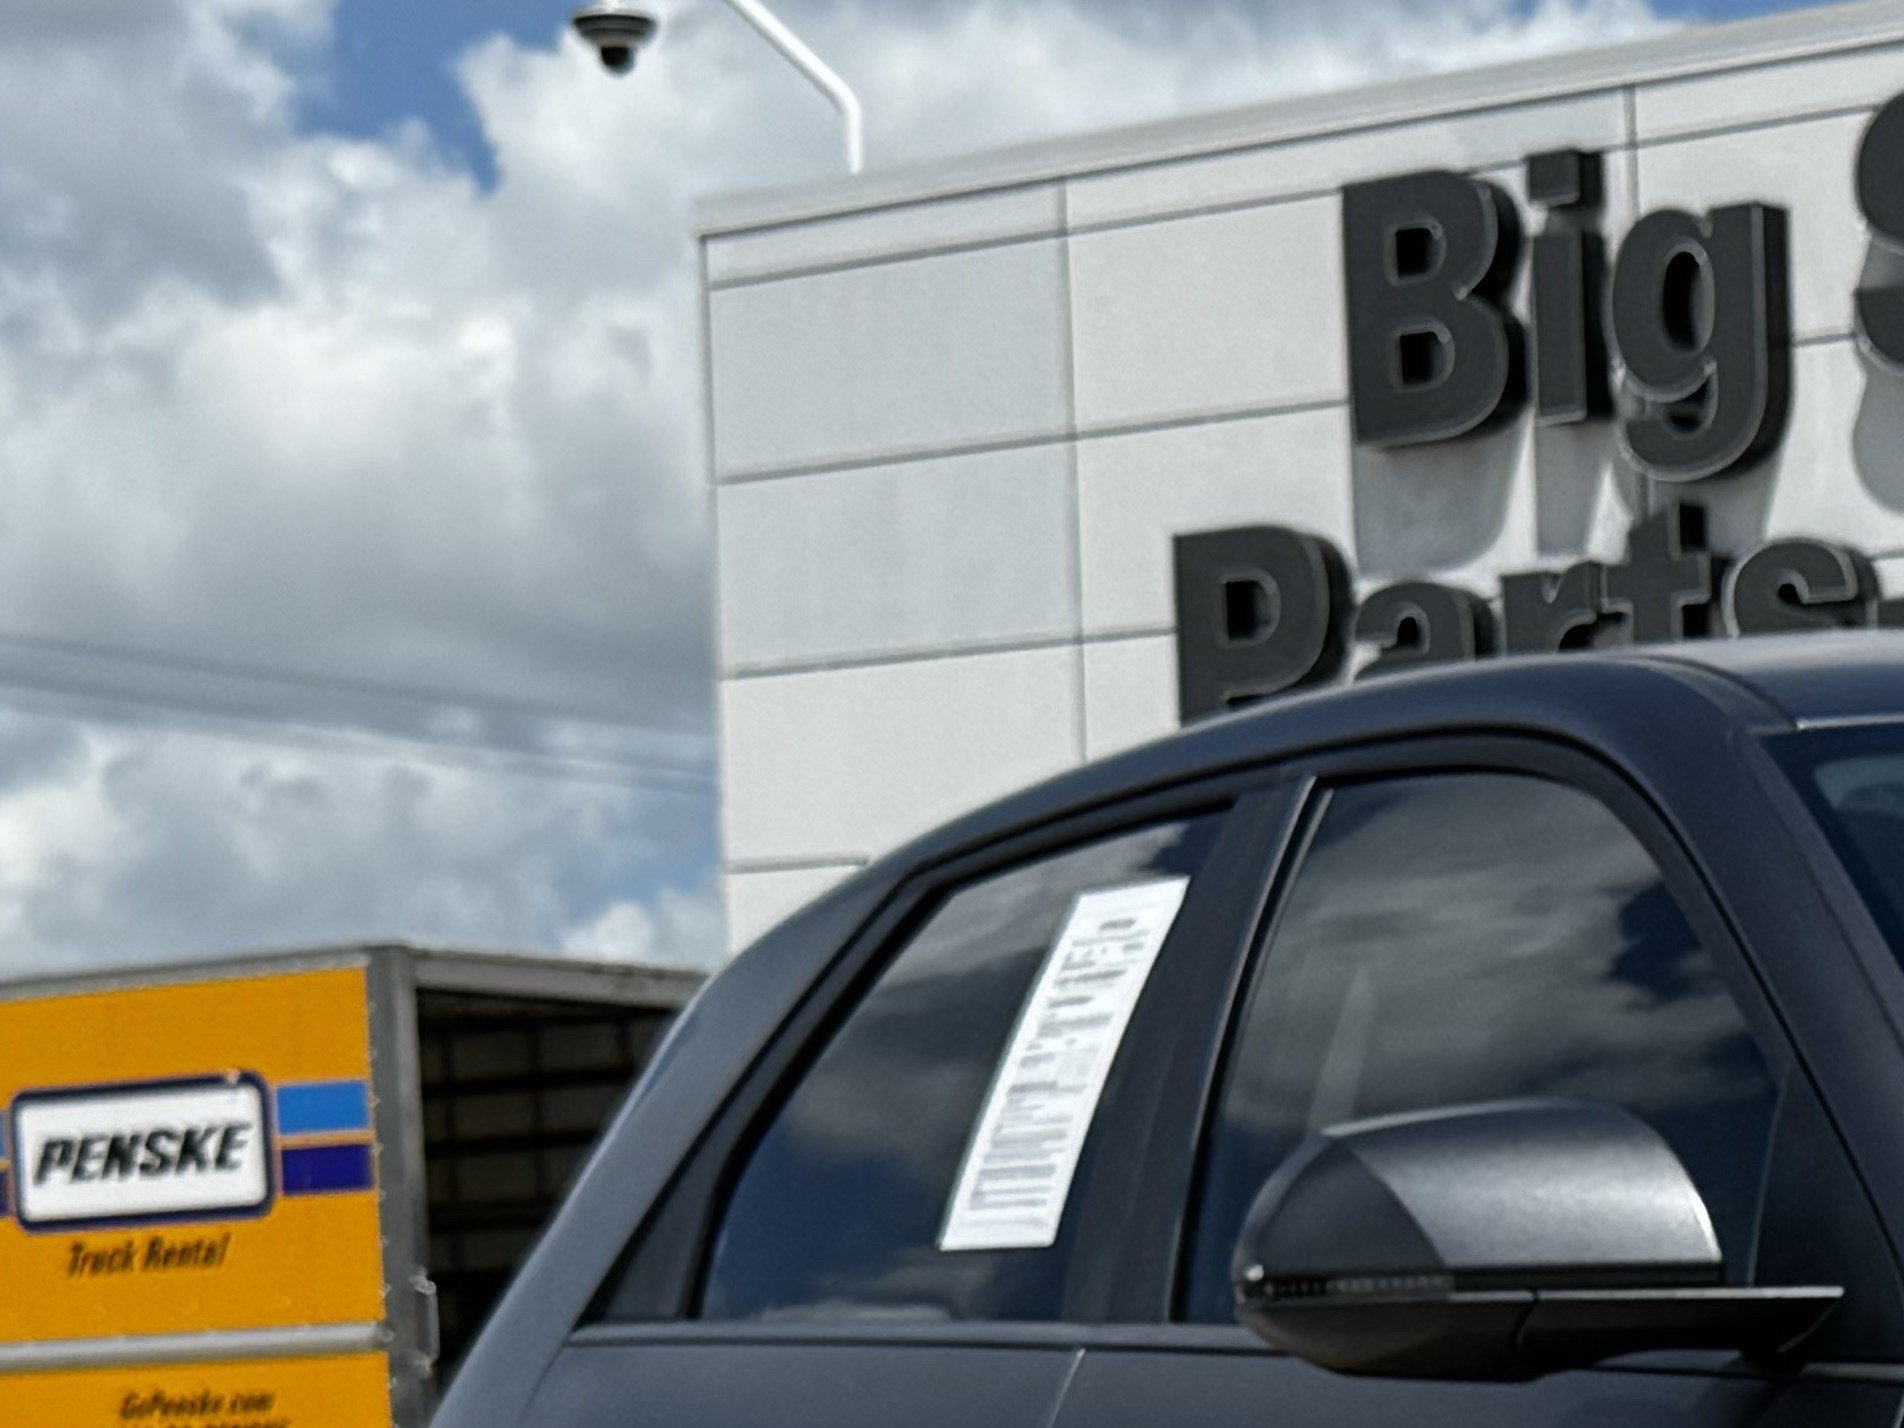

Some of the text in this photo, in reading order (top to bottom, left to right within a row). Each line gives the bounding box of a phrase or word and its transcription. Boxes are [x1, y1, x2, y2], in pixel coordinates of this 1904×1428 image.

[1340, 148, 1792, 482] Big
[33, 1120, 253, 1188] PENSKE
[66, 1231, 232, 1278] Truck Rental
